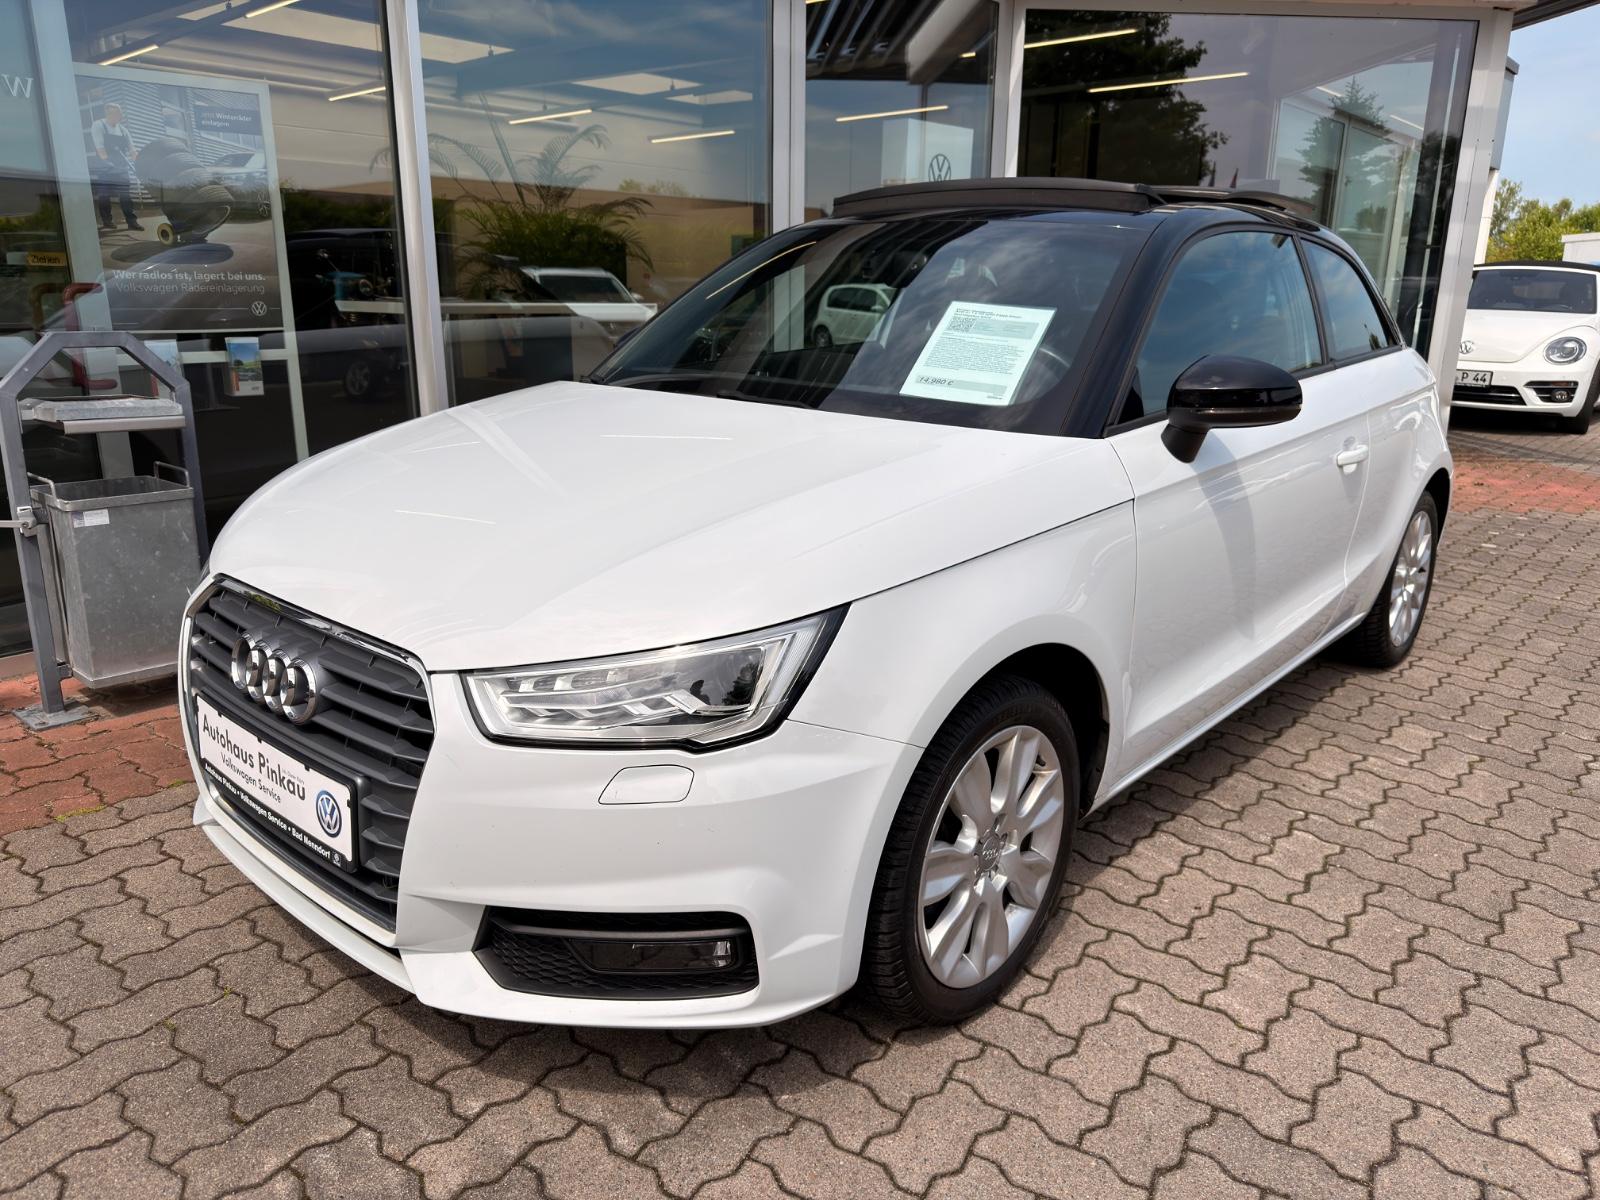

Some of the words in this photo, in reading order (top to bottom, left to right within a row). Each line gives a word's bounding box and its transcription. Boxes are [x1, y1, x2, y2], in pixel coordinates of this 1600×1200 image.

[113, 271, 137, 280] Wer
[139, 271, 172, 280] radlos
[175, 271, 192, 281] ist,
[194, 272, 225, 282] lagert
[228, 272, 243, 281] bei
[245, 273, 266, 281] uns.
[115, 282, 178, 295] Volkswagen
[182, 282, 265, 295] Rädereinlagerung
[1472, 372, 1487, 383] 44
[203, 713, 255, 769] Autohaus
[258, 751, 306, 801] Pinkau
[220, 751, 257, 787] Volkswagen
[258, 778, 281, 803] Service
[222, 777, 237, 794] Pinkau
[240, 791, 267, 818] Volkswagen
[267, 811, 287, 830] Service
[292, 827, 303, 841] Bad
